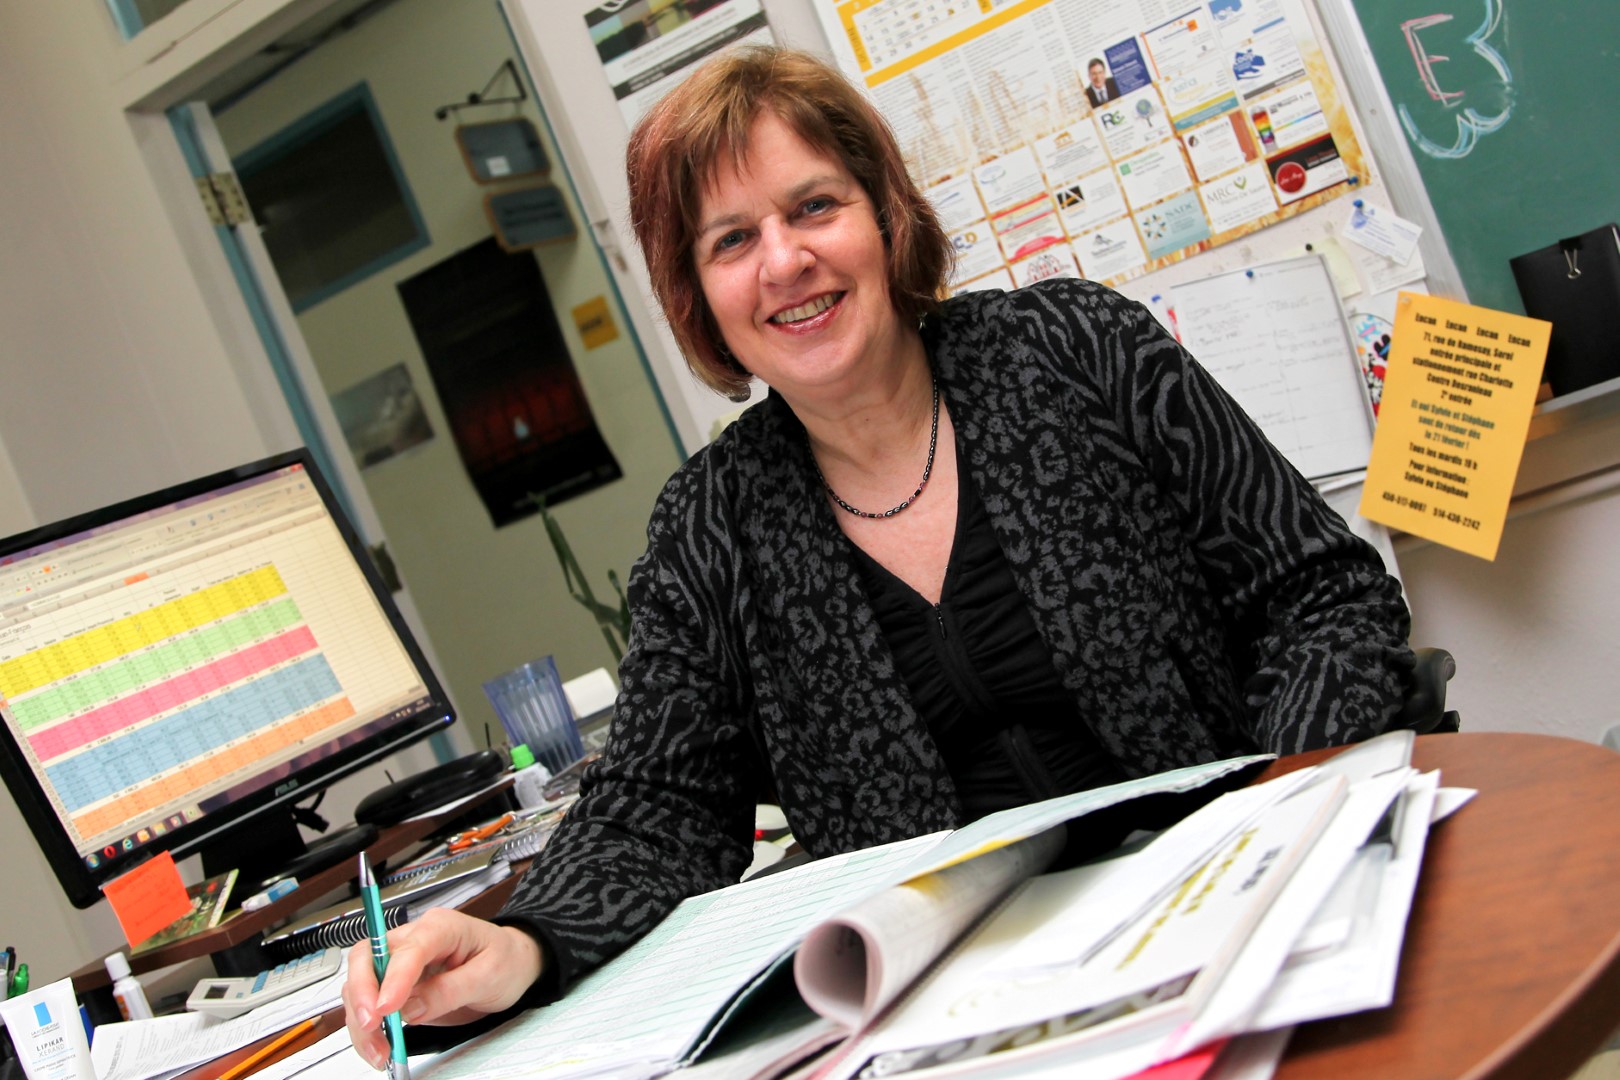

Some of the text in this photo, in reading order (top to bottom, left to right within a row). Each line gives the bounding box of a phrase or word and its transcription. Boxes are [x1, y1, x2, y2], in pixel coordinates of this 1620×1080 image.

[1415, 312, 1531, 348] Encan Encan Encan Encan
[1433, 335, 1446, 345] rue
[1447, 338, 1456, 347] de
[1412, 356, 1514, 388] stationnement rue Charlotte
[1454, 354, 1492, 370] principale
[1494, 363, 1502, 372] et
[1426, 372, 1450, 386] Centre
[1431, 404, 1452, 418] Sylvie
[1452, 412, 1460, 420] et
[1462, 412, 1495, 430] Stéphane
[1435, 420, 1444, 429] de
[1444, 423, 1467, 435] retour
[1410, 441, 1425, 454] Tous
[1426, 447, 1437, 458] les
[1438, 452, 1462, 466] mardis
[1409, 459, 1424, 472] Pour
[1426, 465, 1466, 484] information
[1404, 471, 1469, 499] Sylvie ou Stéphane
[36, 1036, 64, 1052] LIPIKAR
